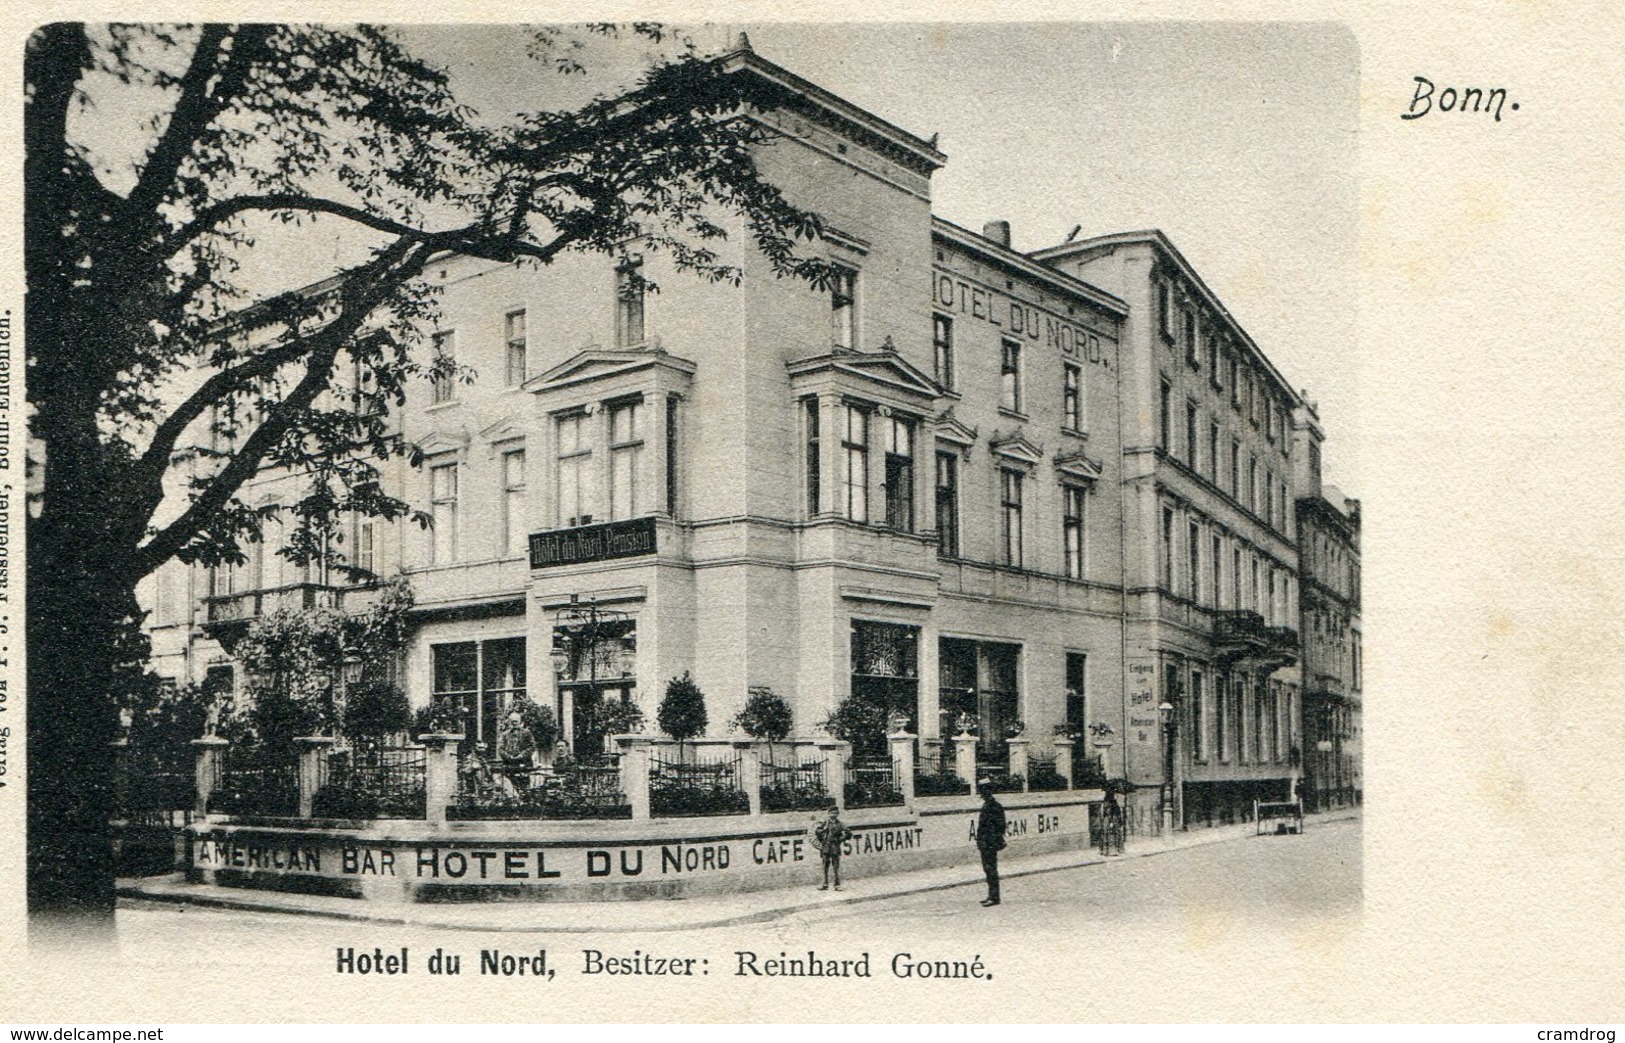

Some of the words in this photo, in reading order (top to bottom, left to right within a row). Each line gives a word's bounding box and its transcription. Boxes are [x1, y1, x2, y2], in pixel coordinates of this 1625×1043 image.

[1400, 76, 1520, 122] Bonn.
[1010, 303, 1040, 340] DU
[577, 531, 602, 558] Nord
[605, 527, 651, 555] Pension
[1131, 687, 1153, 707] Hotel
[1038, 814, 1059, 834] BAR
[199, 838, 321, 873] AMERICAN
[342, 849, 396, 876] BAR
[416, 850, 562, 879] HOTEL
[587, 849, 642, 877] DU
[661, 845, 730, 874] NORD
[752, 839, 804, 865] CAFE
[843, 828, 923, 856] STAURANT
[336, 946, 410, 975] Hotel
[427, 946, 460, 976] du
[480, 948, 556, 981] Nord,
[581, 948, 710, 977] Besitzer:
[733, 949, 872, 979] Reinhard
[890, 952, 994, 981] Gonné.
